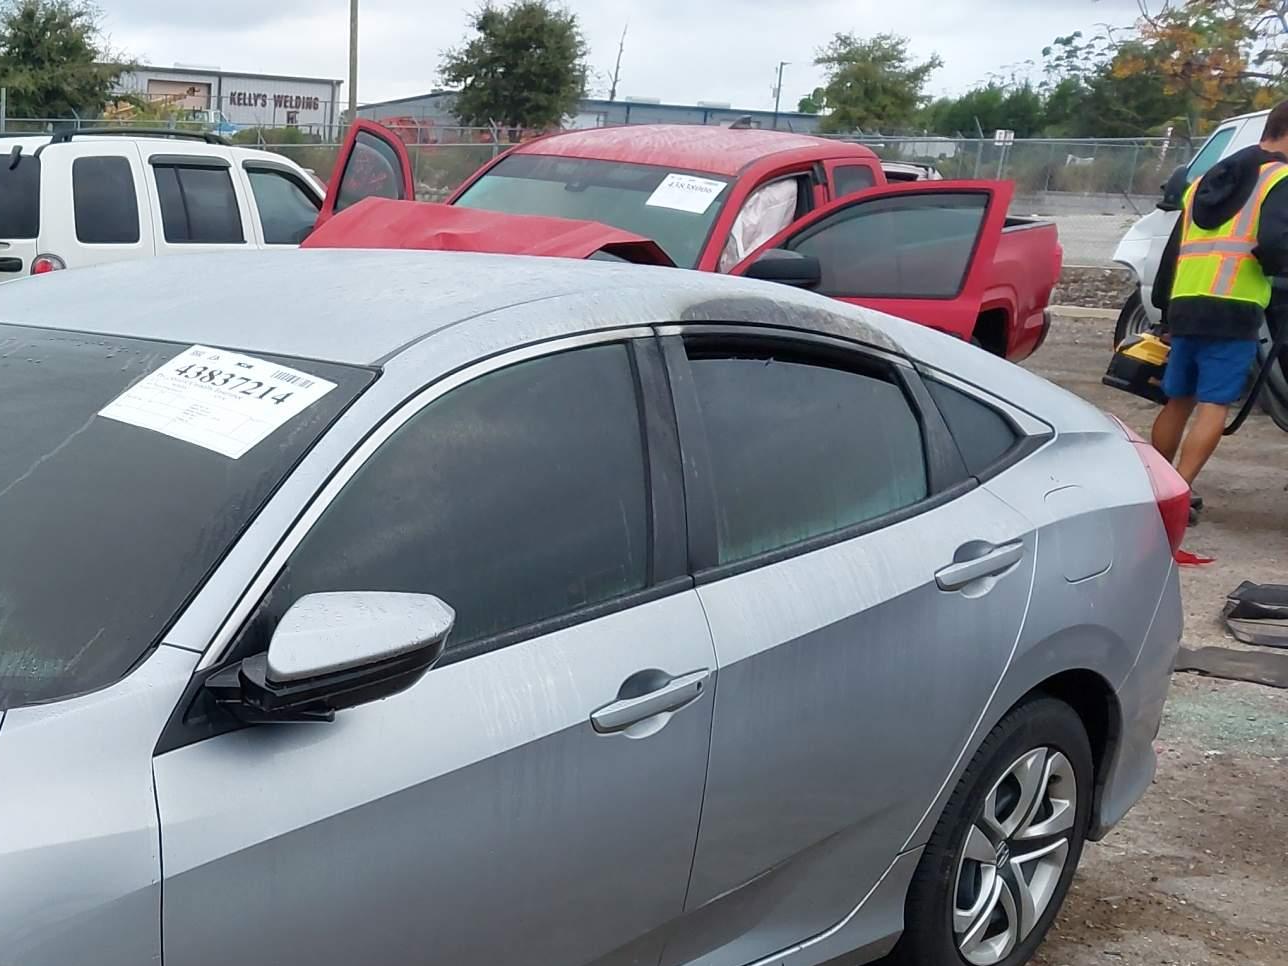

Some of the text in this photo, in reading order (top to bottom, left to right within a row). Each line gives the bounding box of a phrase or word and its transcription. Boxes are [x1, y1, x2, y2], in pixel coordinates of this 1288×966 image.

[229, 90, 320, 111] KELLY'S WELDING
[174, 362, 294, 405] 43837214
